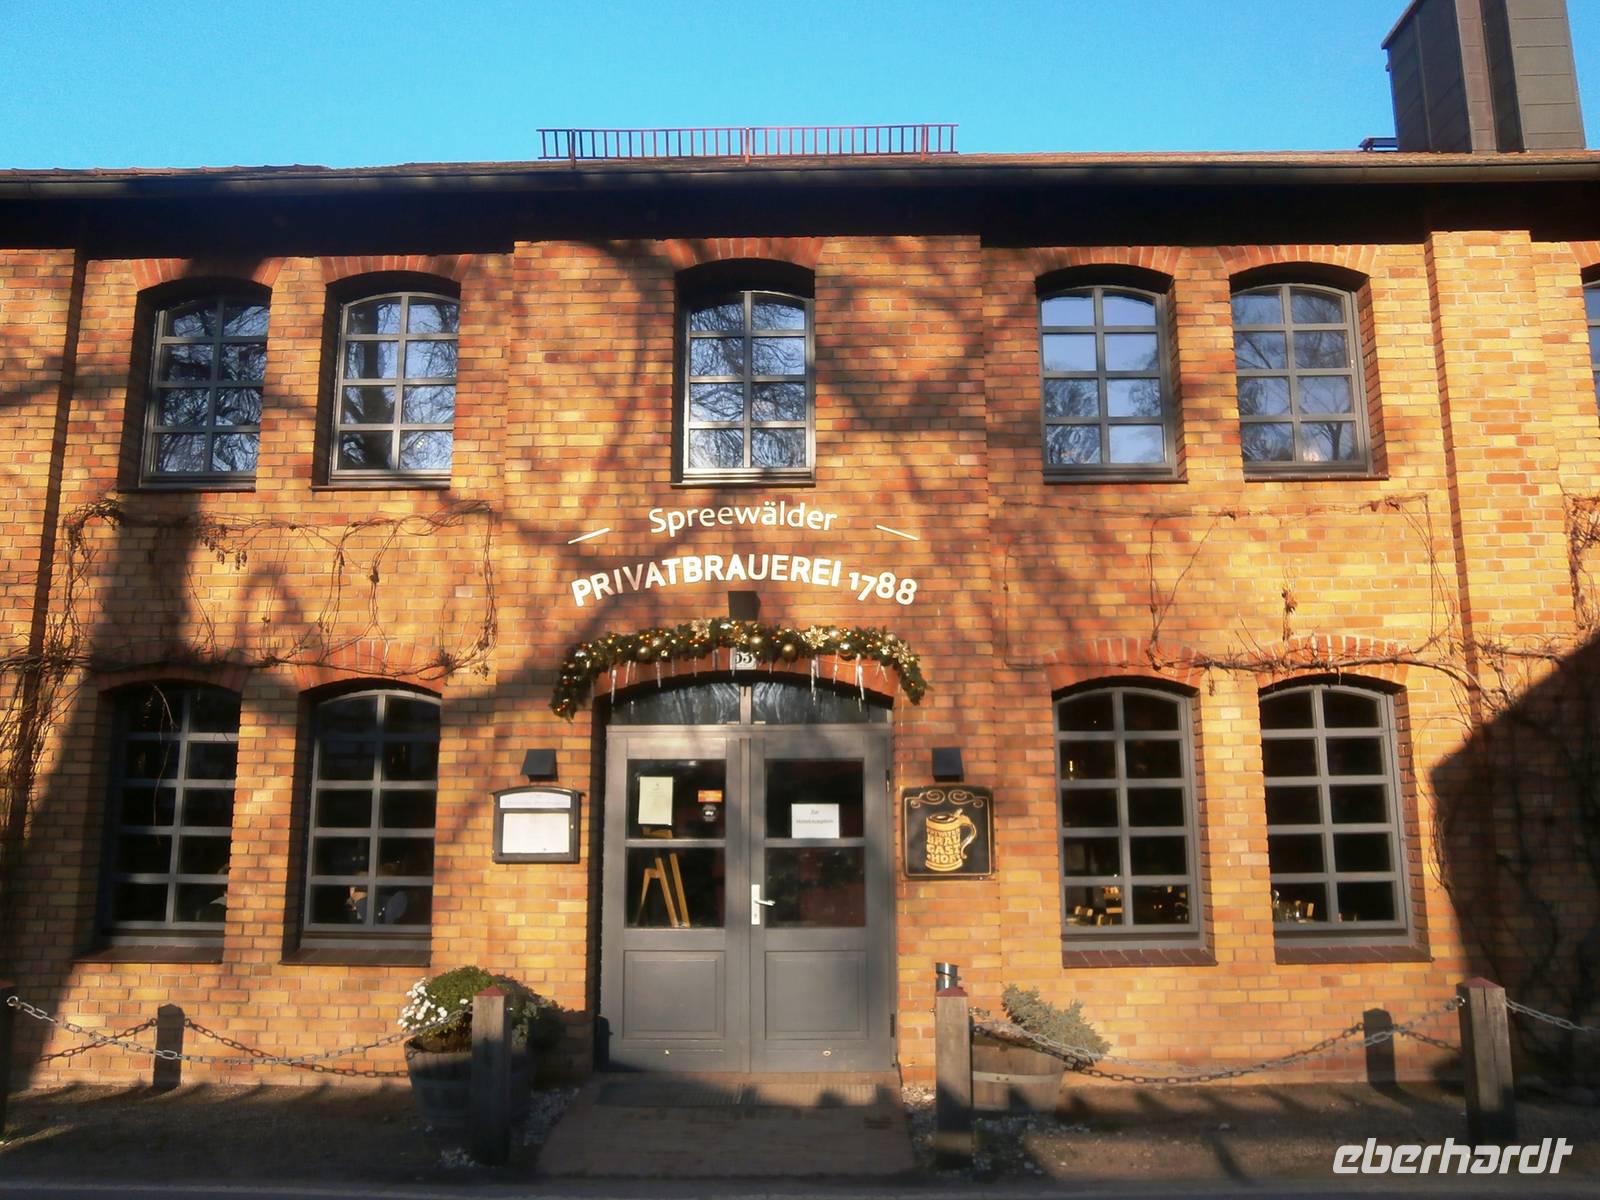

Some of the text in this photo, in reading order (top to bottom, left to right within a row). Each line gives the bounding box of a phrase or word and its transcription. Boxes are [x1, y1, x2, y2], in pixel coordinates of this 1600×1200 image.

[648, 500, 838, 538] Spreewälder
[571, 553, 918, 607] PRIVATBRAUEREI 1788
